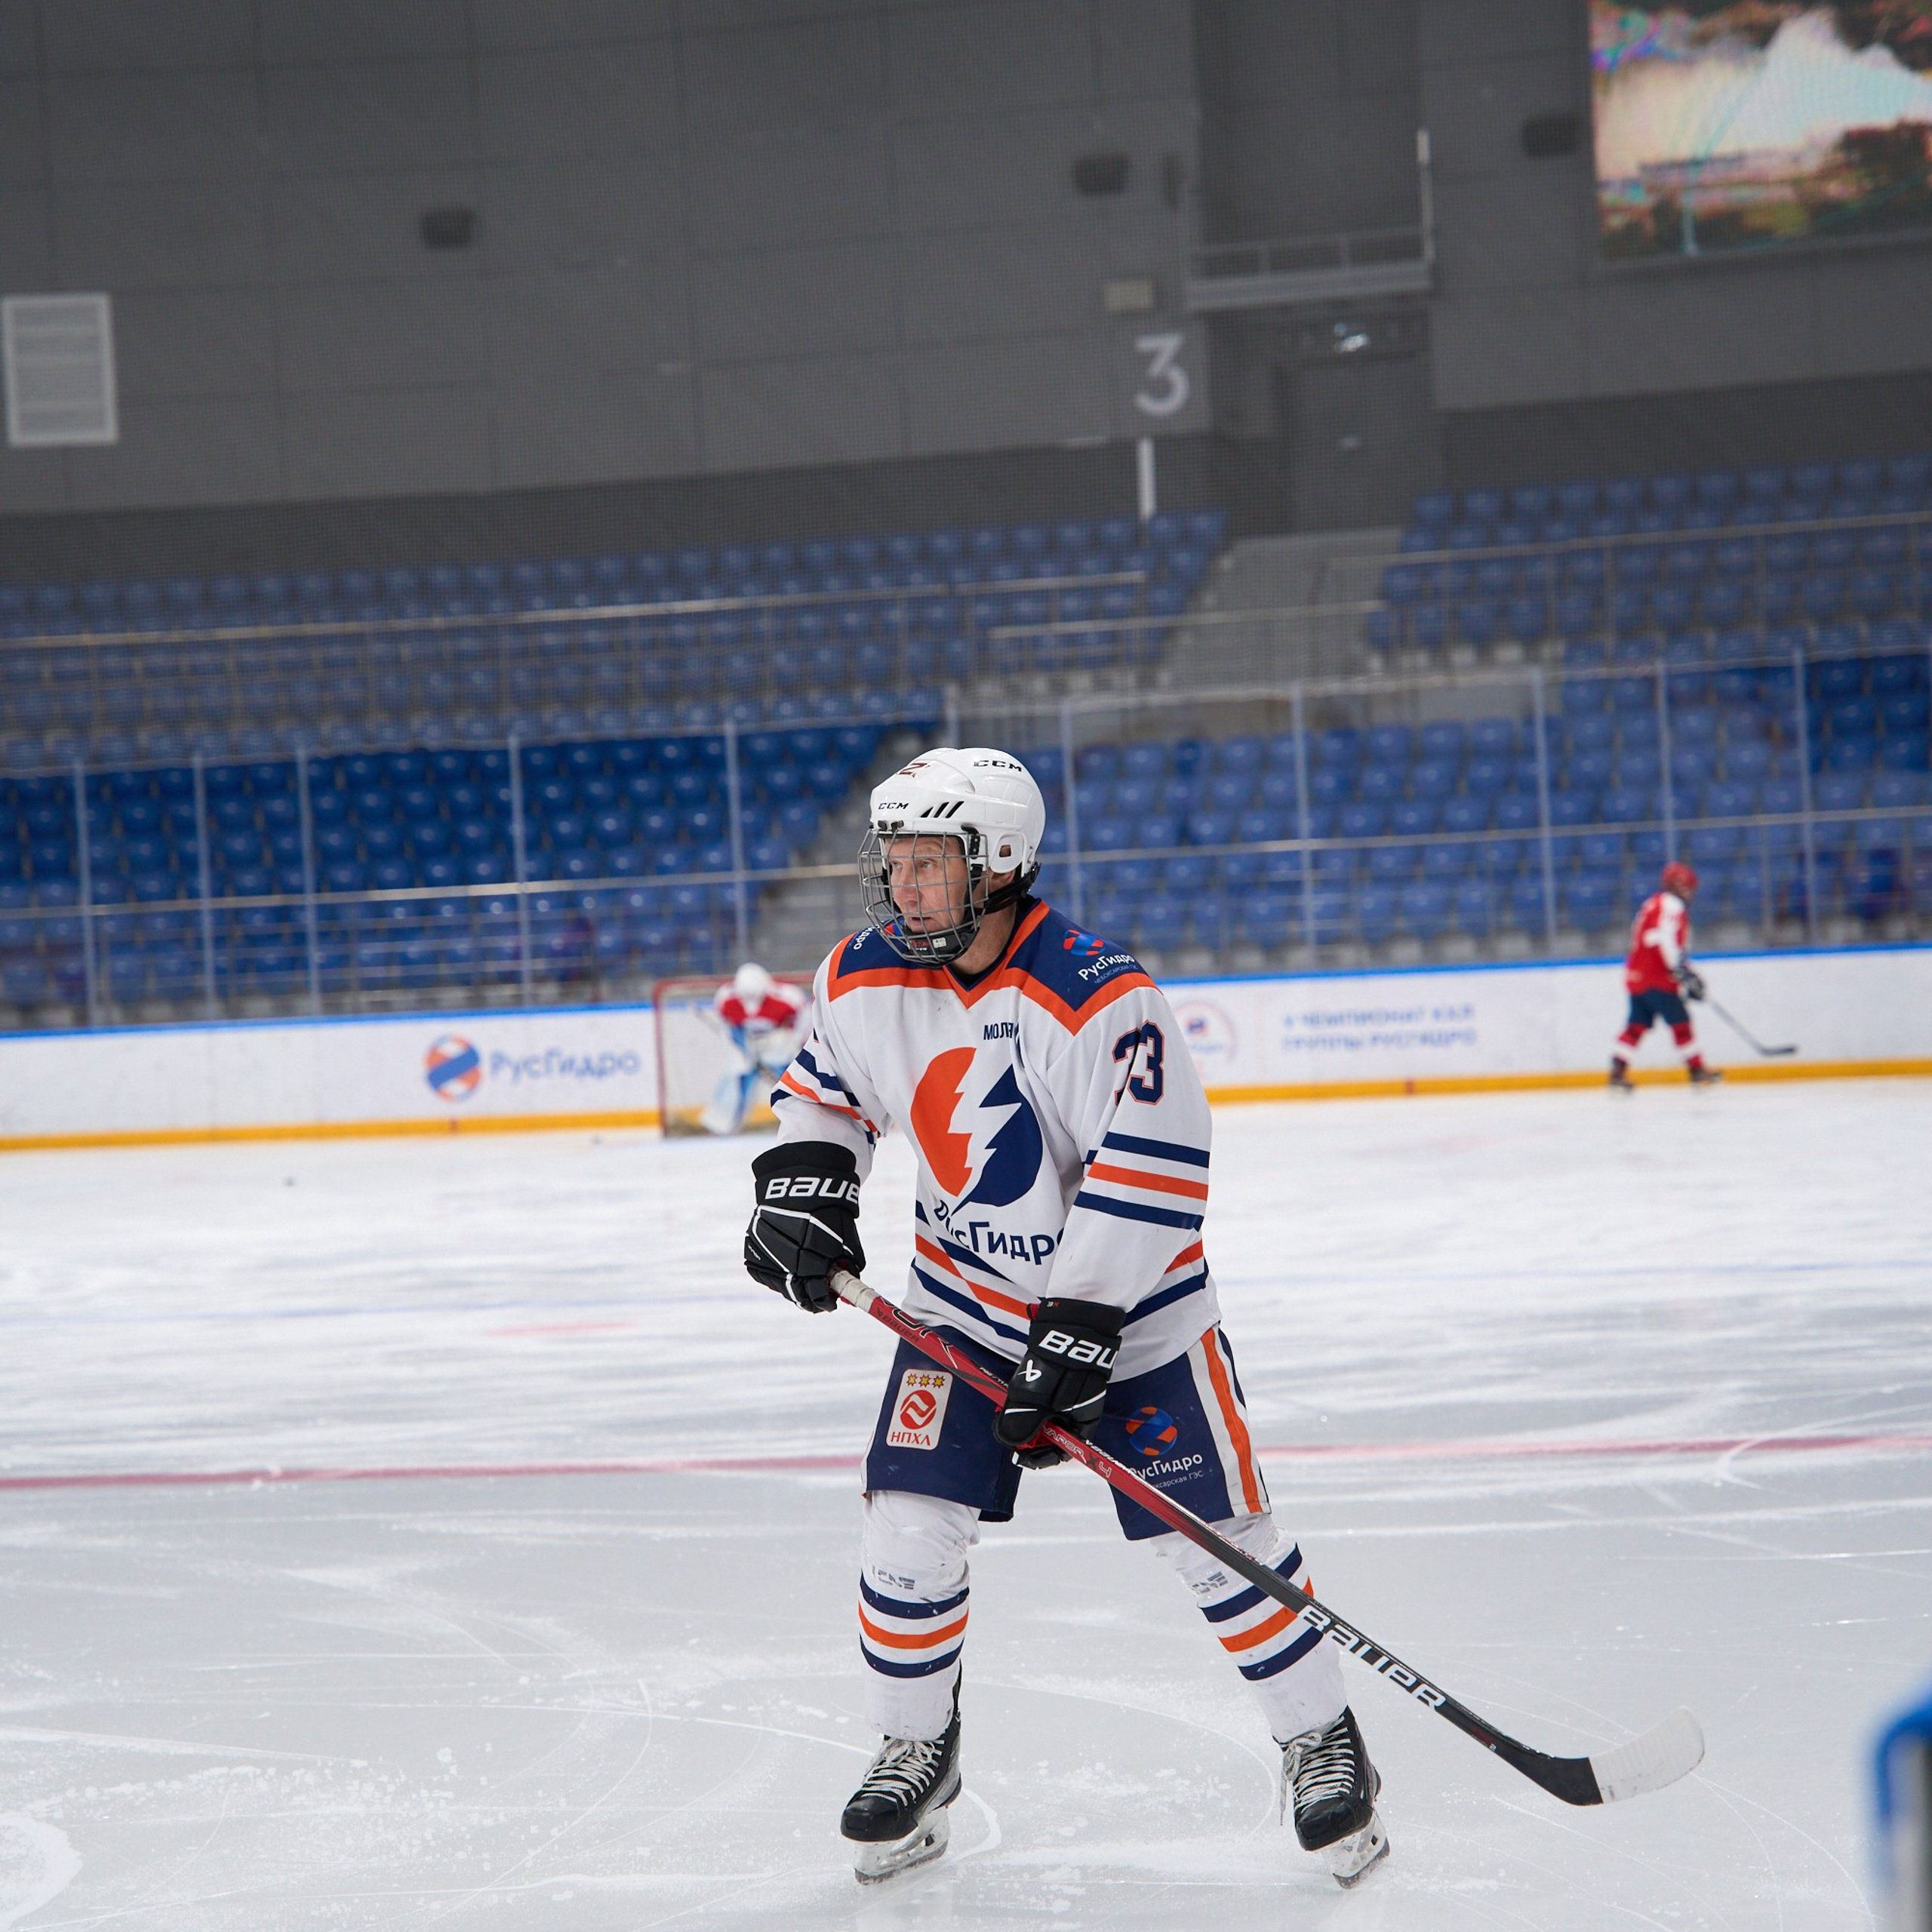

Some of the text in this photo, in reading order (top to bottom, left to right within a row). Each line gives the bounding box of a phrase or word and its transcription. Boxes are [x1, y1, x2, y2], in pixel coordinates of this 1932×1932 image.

[1134, 332, 1189, 416] 3
[973, 759, 1023, 773] CCM
[878, 801, 909, 810] CCM
[1078, 954, 1135, 981] РусГидро
[490, 1046, 641, 1085] РусГидро
[891, 1432, 931, 1446] НПХЛ
[1043, 1426, 1087, 1464] VAPOR
[1189, 1470, 1204, 1479] ГЭС
[1297, 1604, 1447, 1709] BAUER
